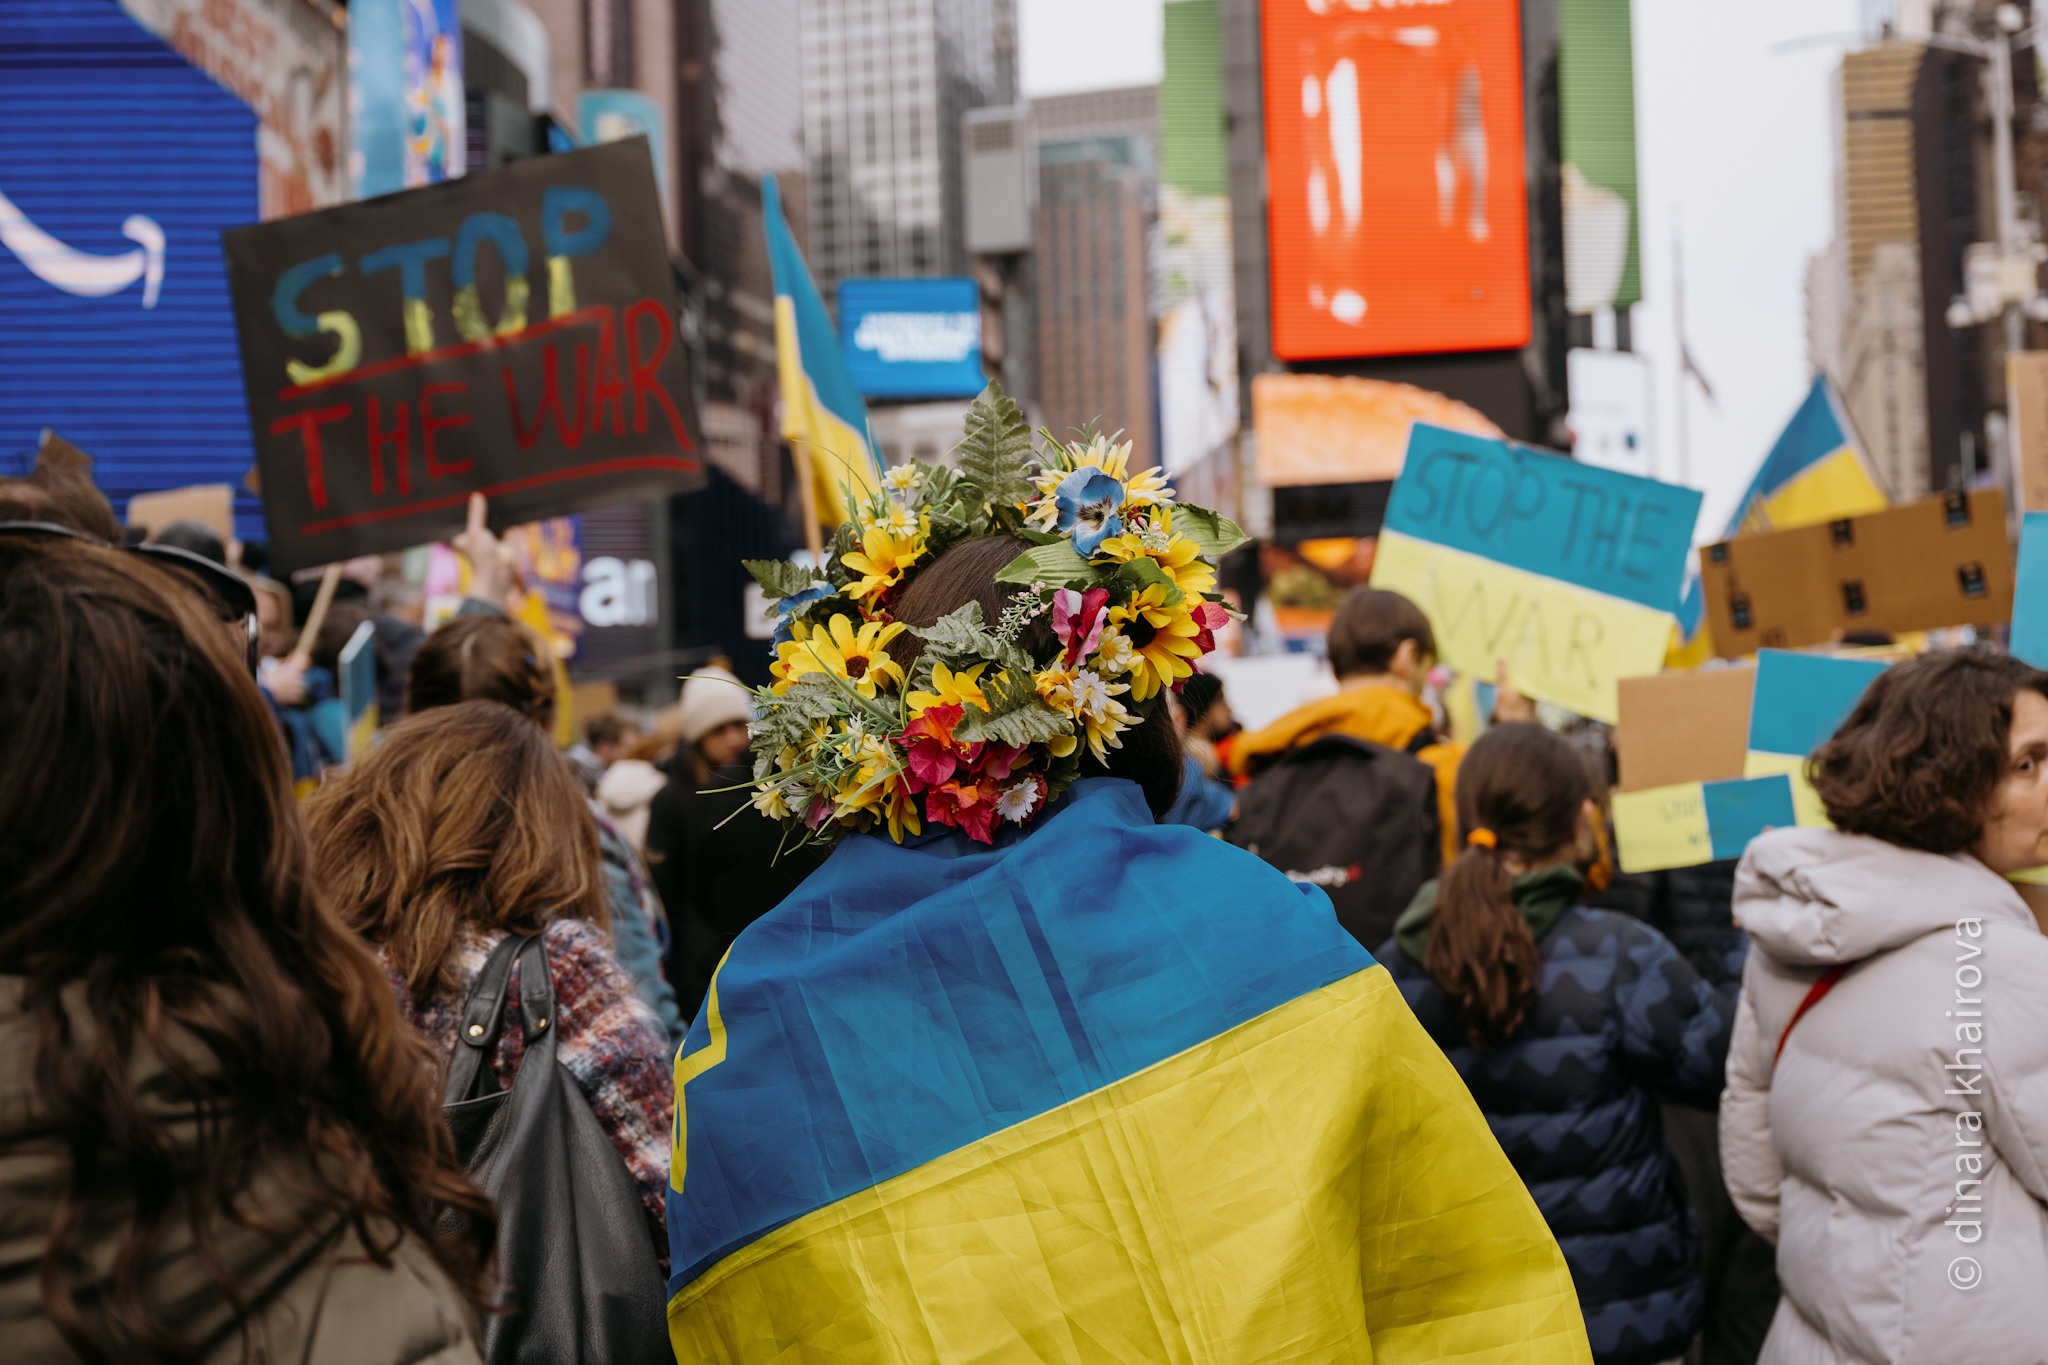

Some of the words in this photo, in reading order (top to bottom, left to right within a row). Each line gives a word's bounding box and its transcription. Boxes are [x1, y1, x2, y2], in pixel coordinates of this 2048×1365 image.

[270, 185, 611, 387] STOP
[269, 382, 474, 510] THE
[502, 299, 696, 451] WAR
[1404, 448, 1548, 540] STOP
[1560, 477, 1671, 582] THE
[1428, 570, 1605, 690] WAR
